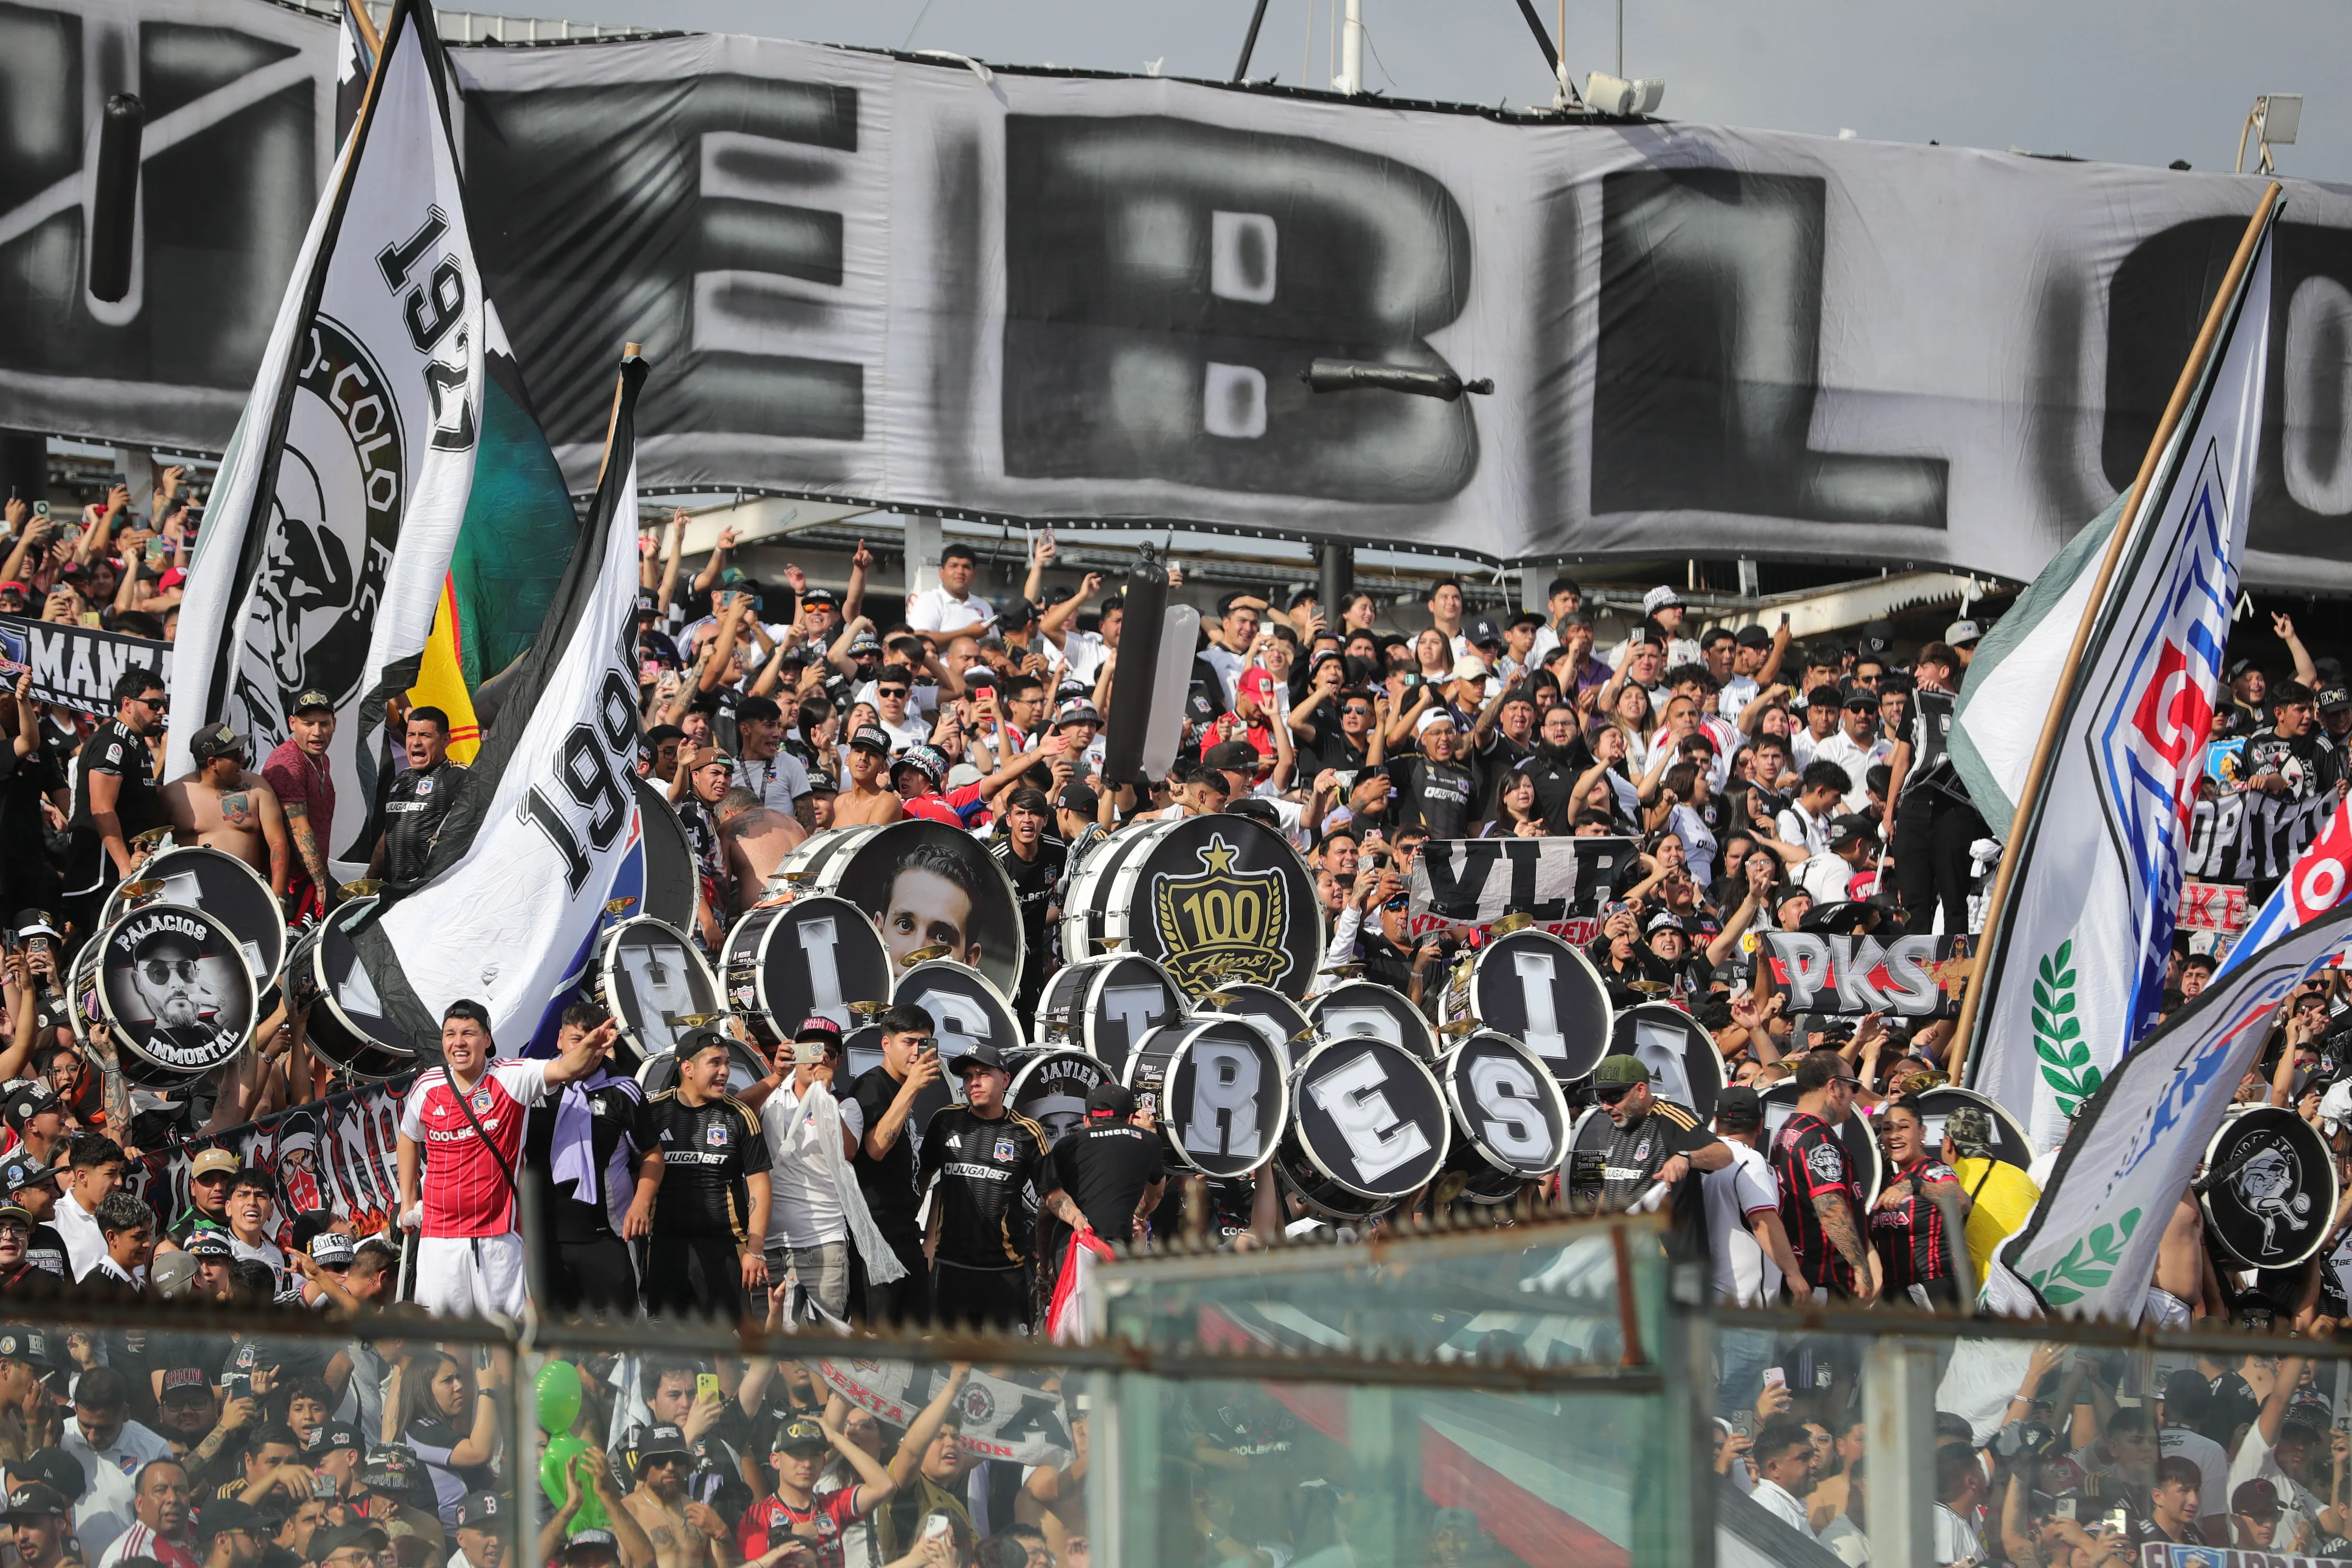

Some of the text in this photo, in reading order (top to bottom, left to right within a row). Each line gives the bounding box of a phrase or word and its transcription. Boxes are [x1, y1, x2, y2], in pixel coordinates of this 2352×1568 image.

[115, 914, 207, 952] PALACIOS
[1183, 888, 1260, 947] 100
[1767, 931, 1940, 1015] PKS
[145, 1028, 239, 1065] INMORTAL
[1041, 1061, 1099, 1090] JAVIER
[429, 1125, 475, 1142] COOLBE
[819, 1358, 904, 1423] SEXTA
